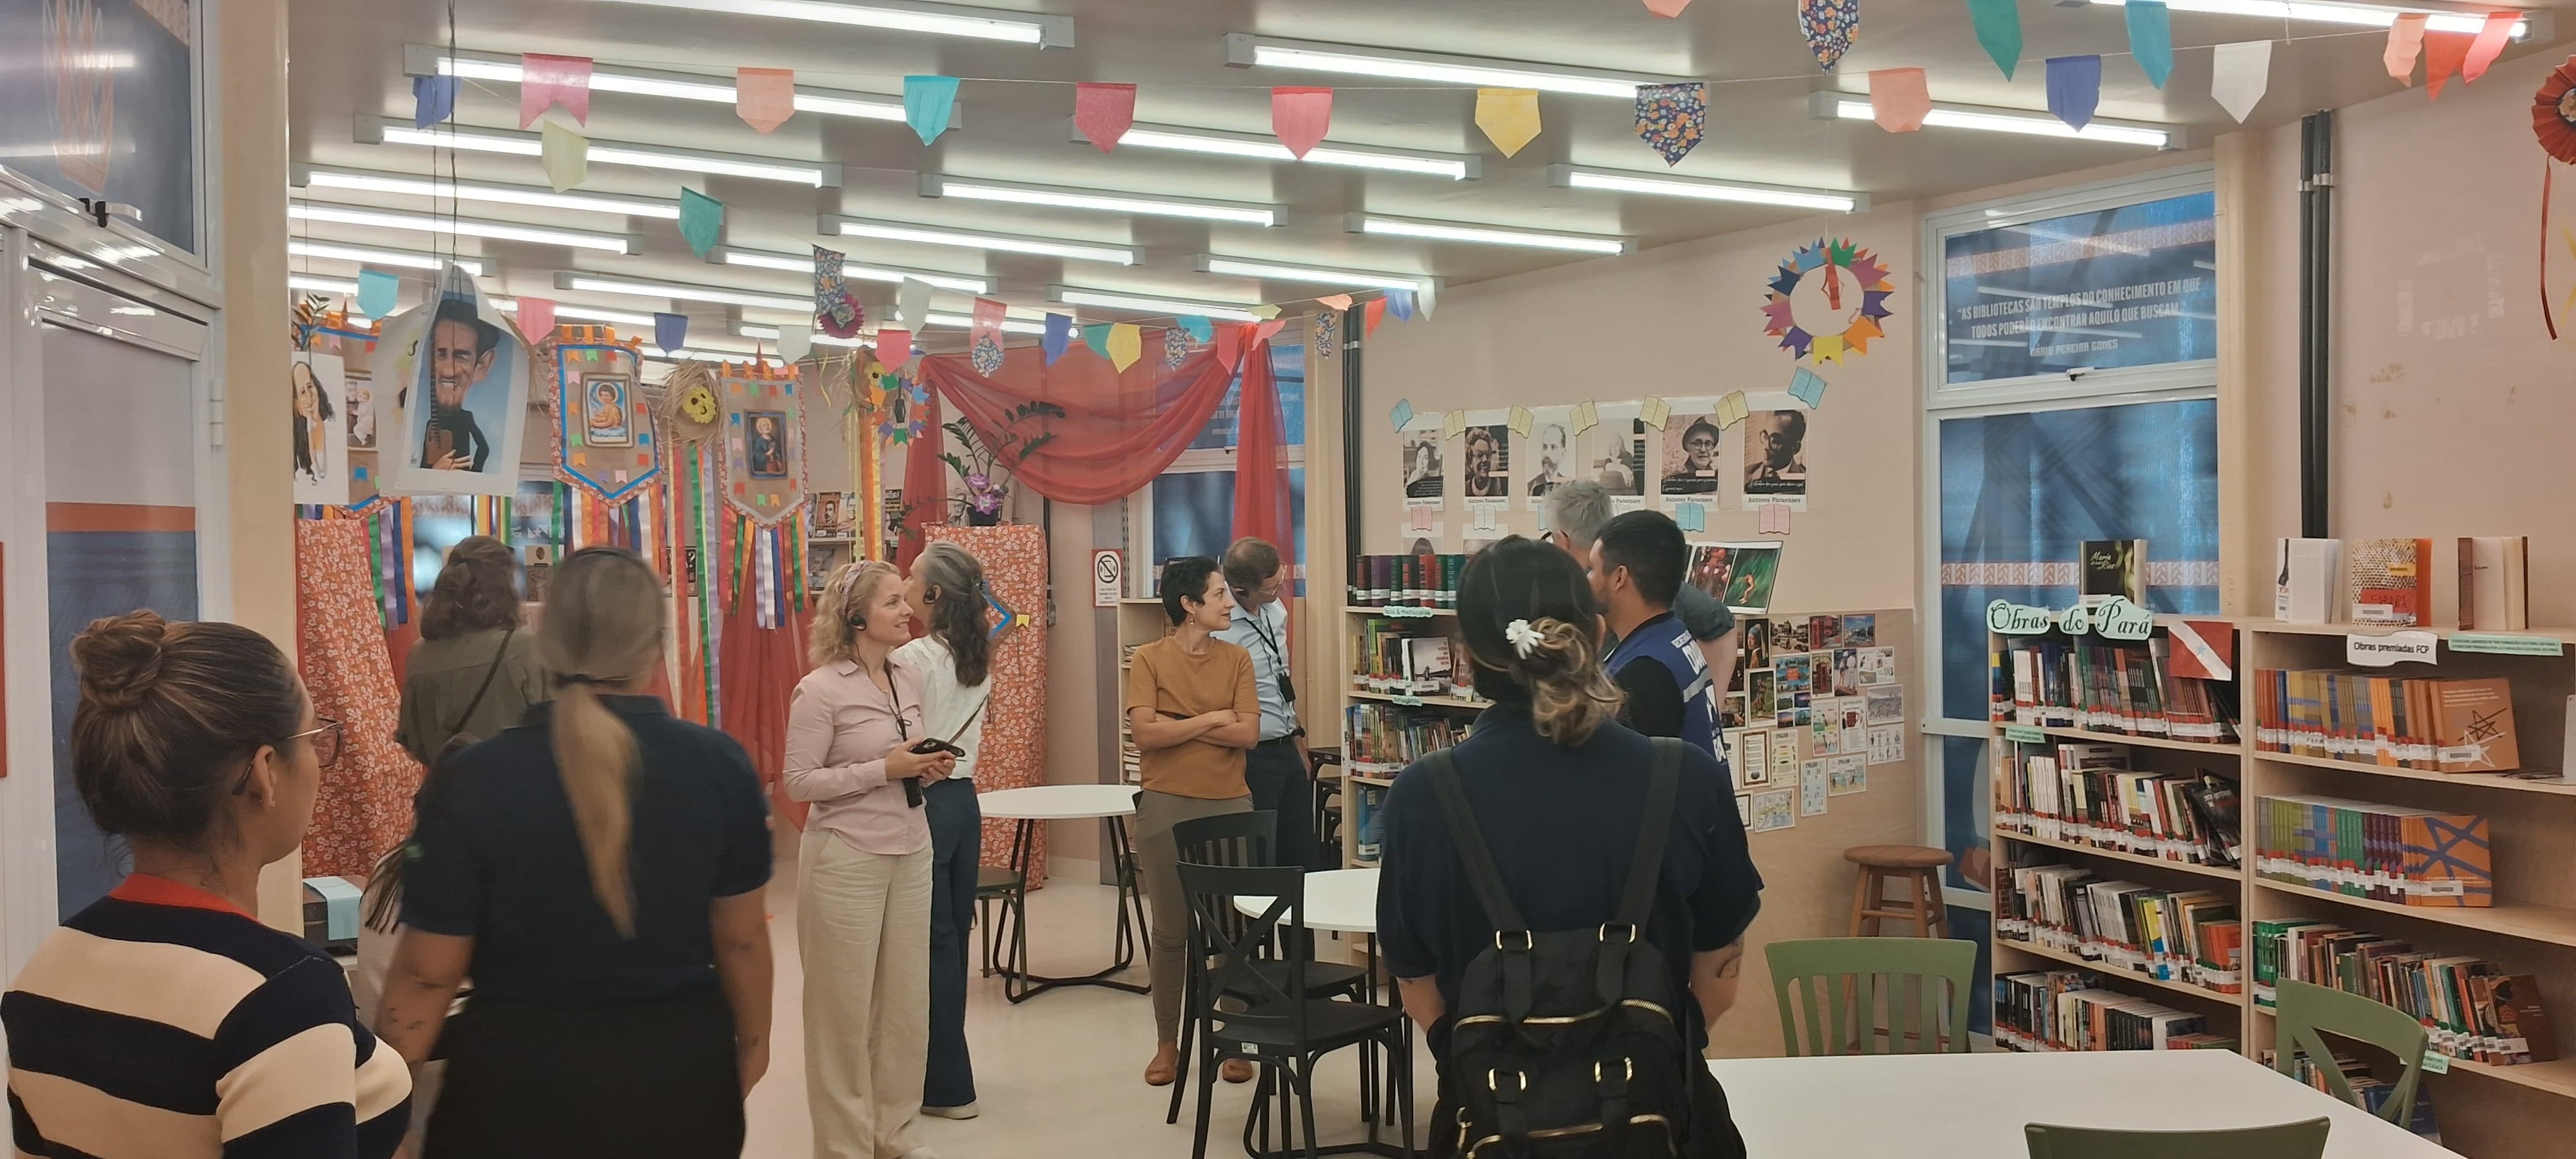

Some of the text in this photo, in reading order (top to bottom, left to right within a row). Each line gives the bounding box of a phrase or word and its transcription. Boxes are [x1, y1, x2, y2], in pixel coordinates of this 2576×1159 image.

[1972, 299, 2024, 319] BIBLIOTECAS
[2025, 296, 2041, 312] SÃO
[2042, 292, 2082, 309] TEMPLOS
[2083, 290, 2094, 305] DO
[2096, 282, 2166, 304] CONHECIMENTO
[2168, 280, 2181, 295] EM
[2182, 277, 2202, 292] QUE
[1971, 323, 1997, 339] TODOS
[1998, 317, 2036, 336] PODERÃO
[2037, 312, 2088, 332] ENCONTRAR
[2089, 309, 2120, 326] AQUILO
[2121, 306, 2139, 322] QUE
[1991, 598, 2150, 634] Obras do Pará
[2354, 641, 2430, 654] Obras premiadas FCP
